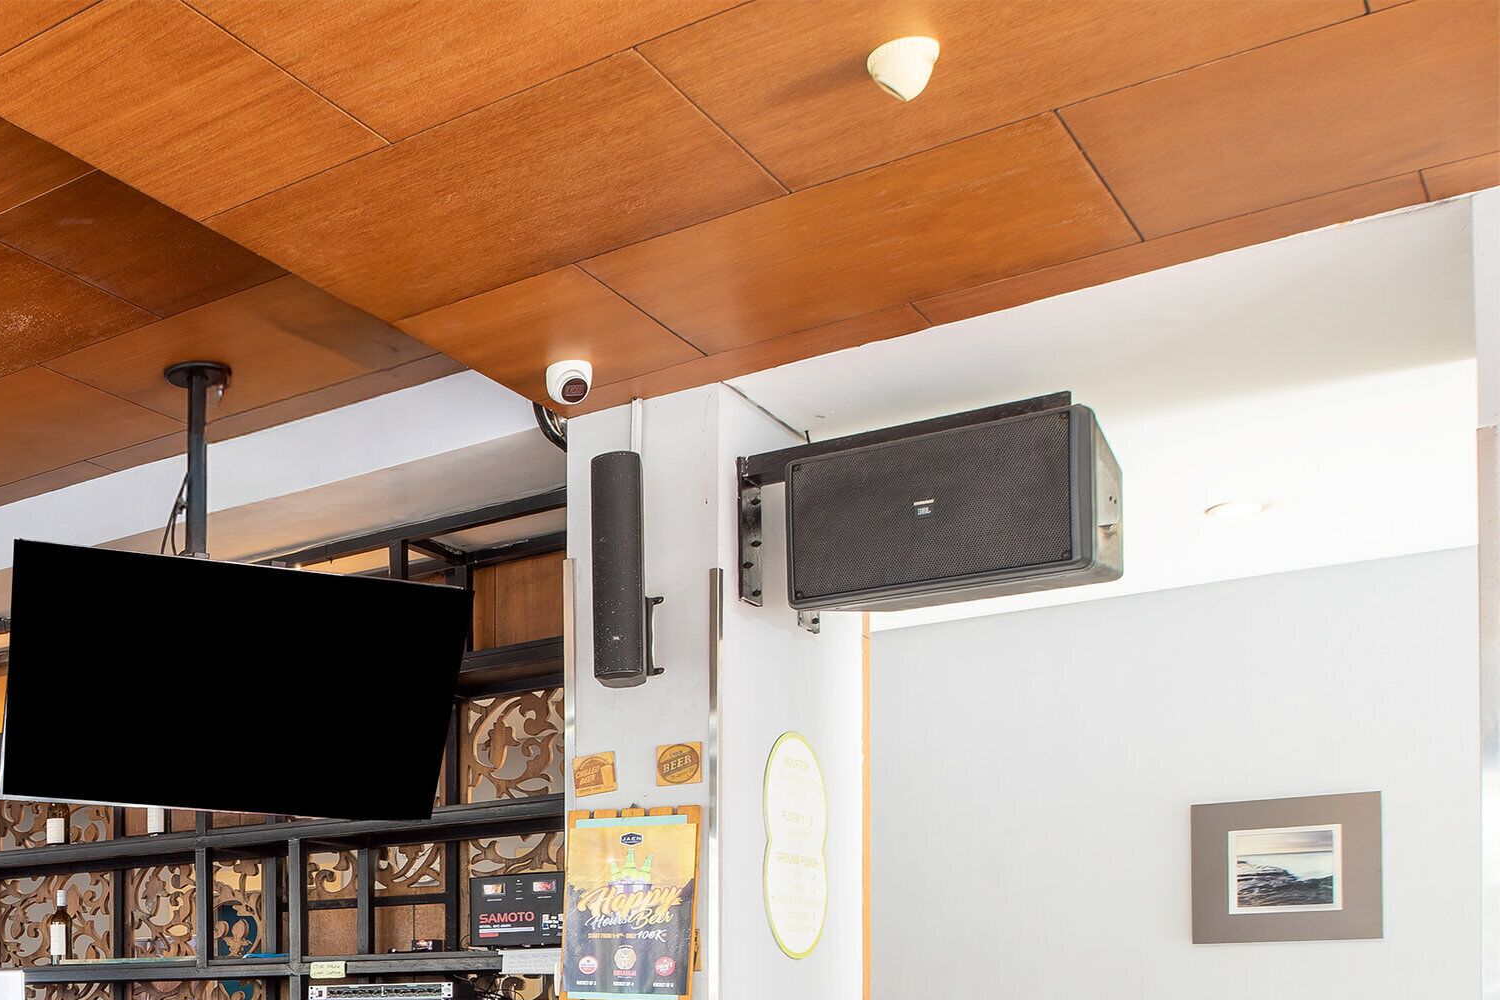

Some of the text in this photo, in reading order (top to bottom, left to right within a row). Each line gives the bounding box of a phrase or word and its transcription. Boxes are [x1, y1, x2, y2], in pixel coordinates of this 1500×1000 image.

[663, 754, 692, 774] BEER
[579, 774, 596, 785] BEER
[577, 886, 683, 918] Happy
[479, 911, 535, 924] SAMOTO
[629, 907, 674, 930] Beer
[636, 929, 668, 943] 100K
